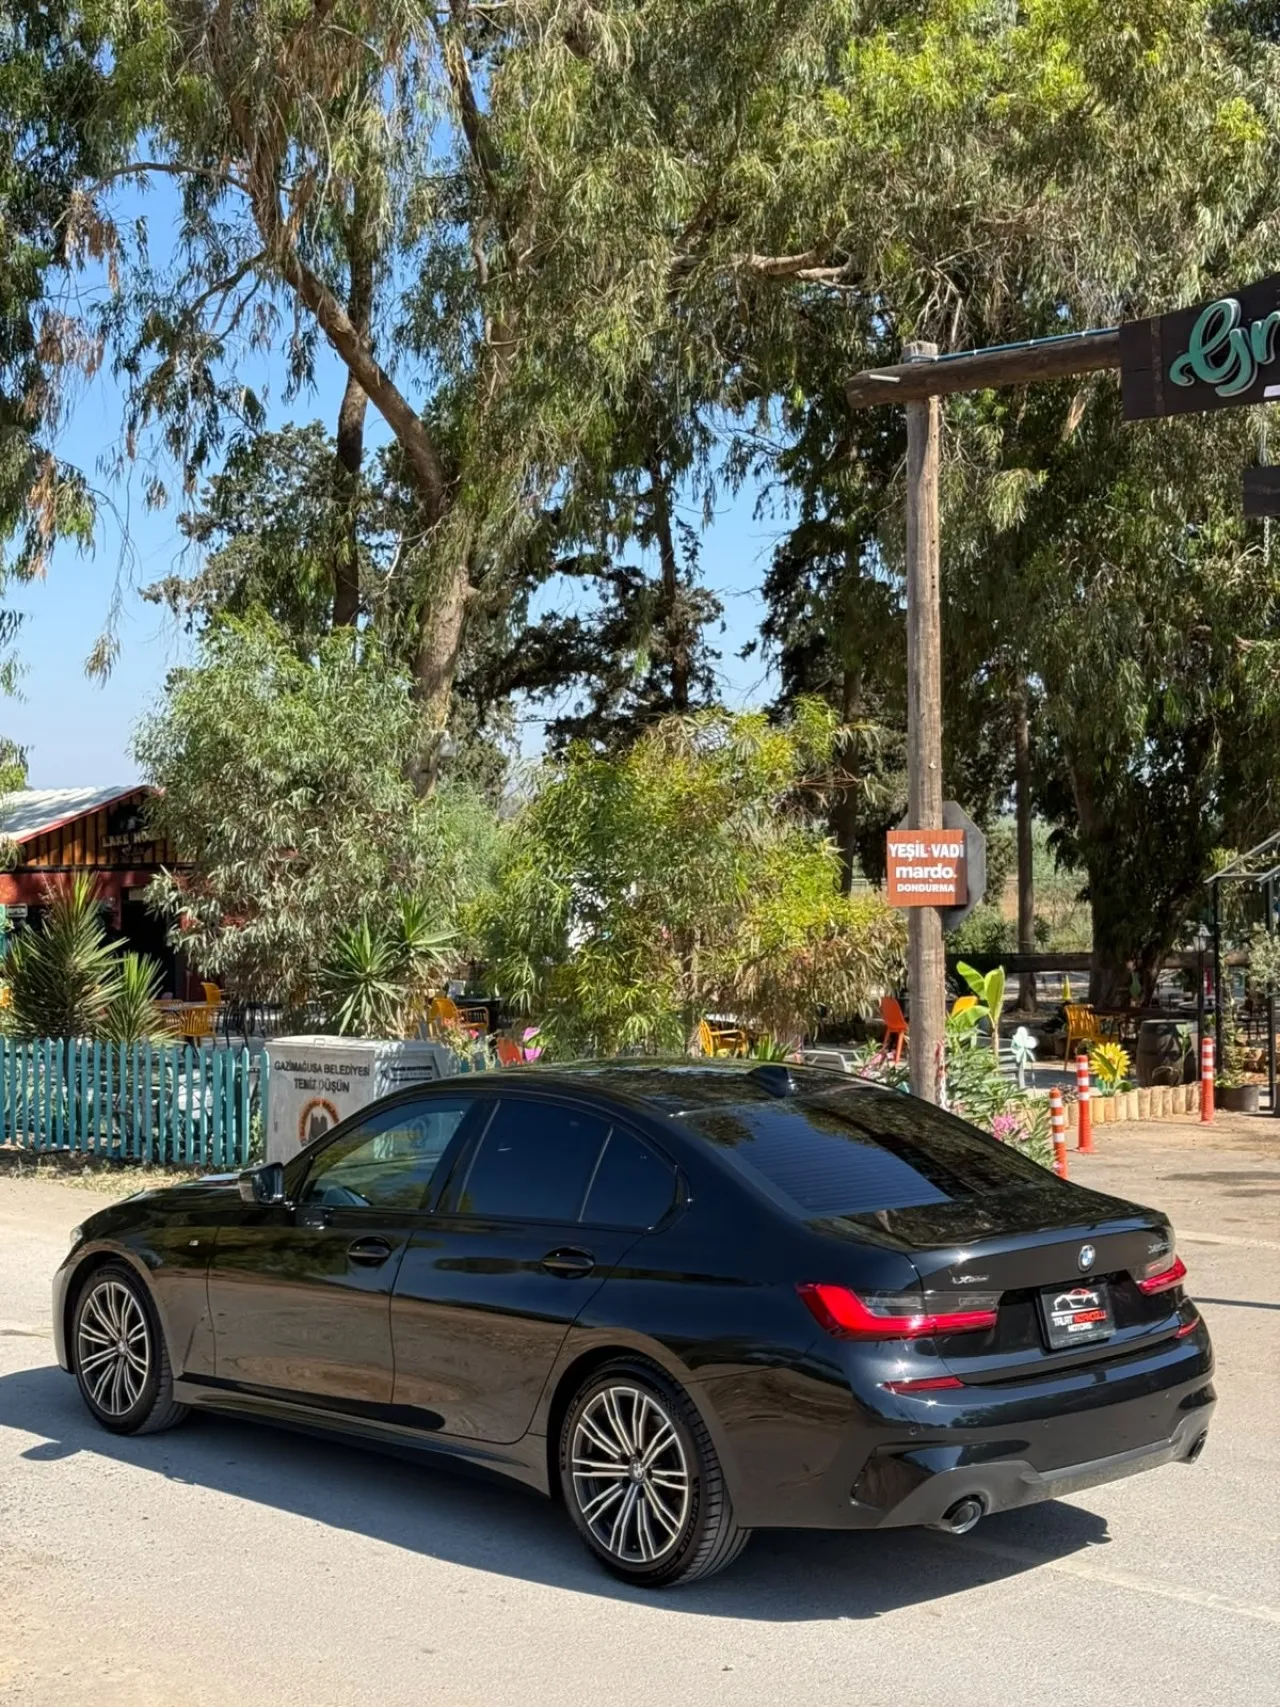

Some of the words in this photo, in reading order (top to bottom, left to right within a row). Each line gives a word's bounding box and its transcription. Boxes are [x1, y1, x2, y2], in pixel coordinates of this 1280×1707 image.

[888, 840, 928, 862] YEŞİL
[931, 840, 964, 858] VADİ
[897, 883, 956, 893] DONDURMA
[324, 1063, 370, 1077] BELEDİYESİ
